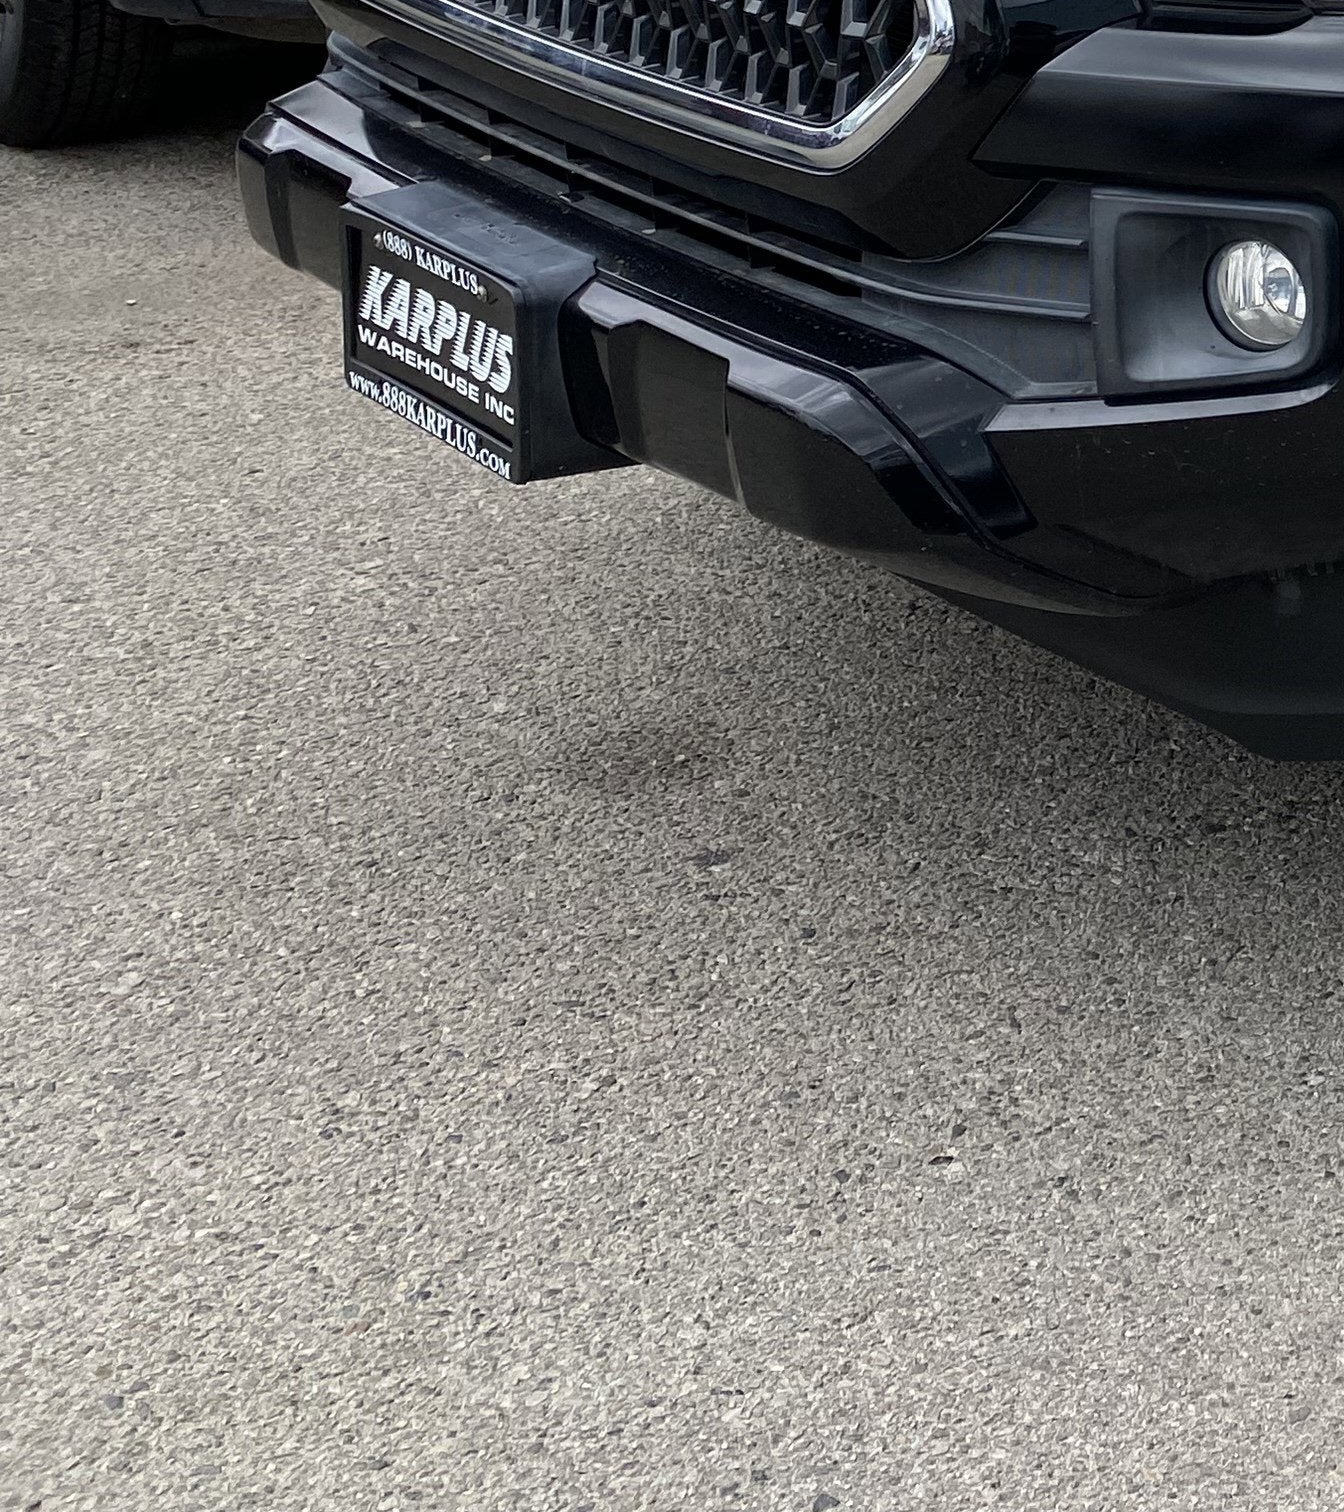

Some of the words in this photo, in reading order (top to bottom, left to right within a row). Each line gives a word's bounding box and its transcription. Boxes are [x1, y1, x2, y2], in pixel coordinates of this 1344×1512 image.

[382, 230, 412, 261] (888)
[415, 246, 479, 295] KARPLUS
[357, 324, 480, 403] WAREHOUSE
[485, 392, 515, 425] INC
[358, 265, 514, 394] KARPLUS
